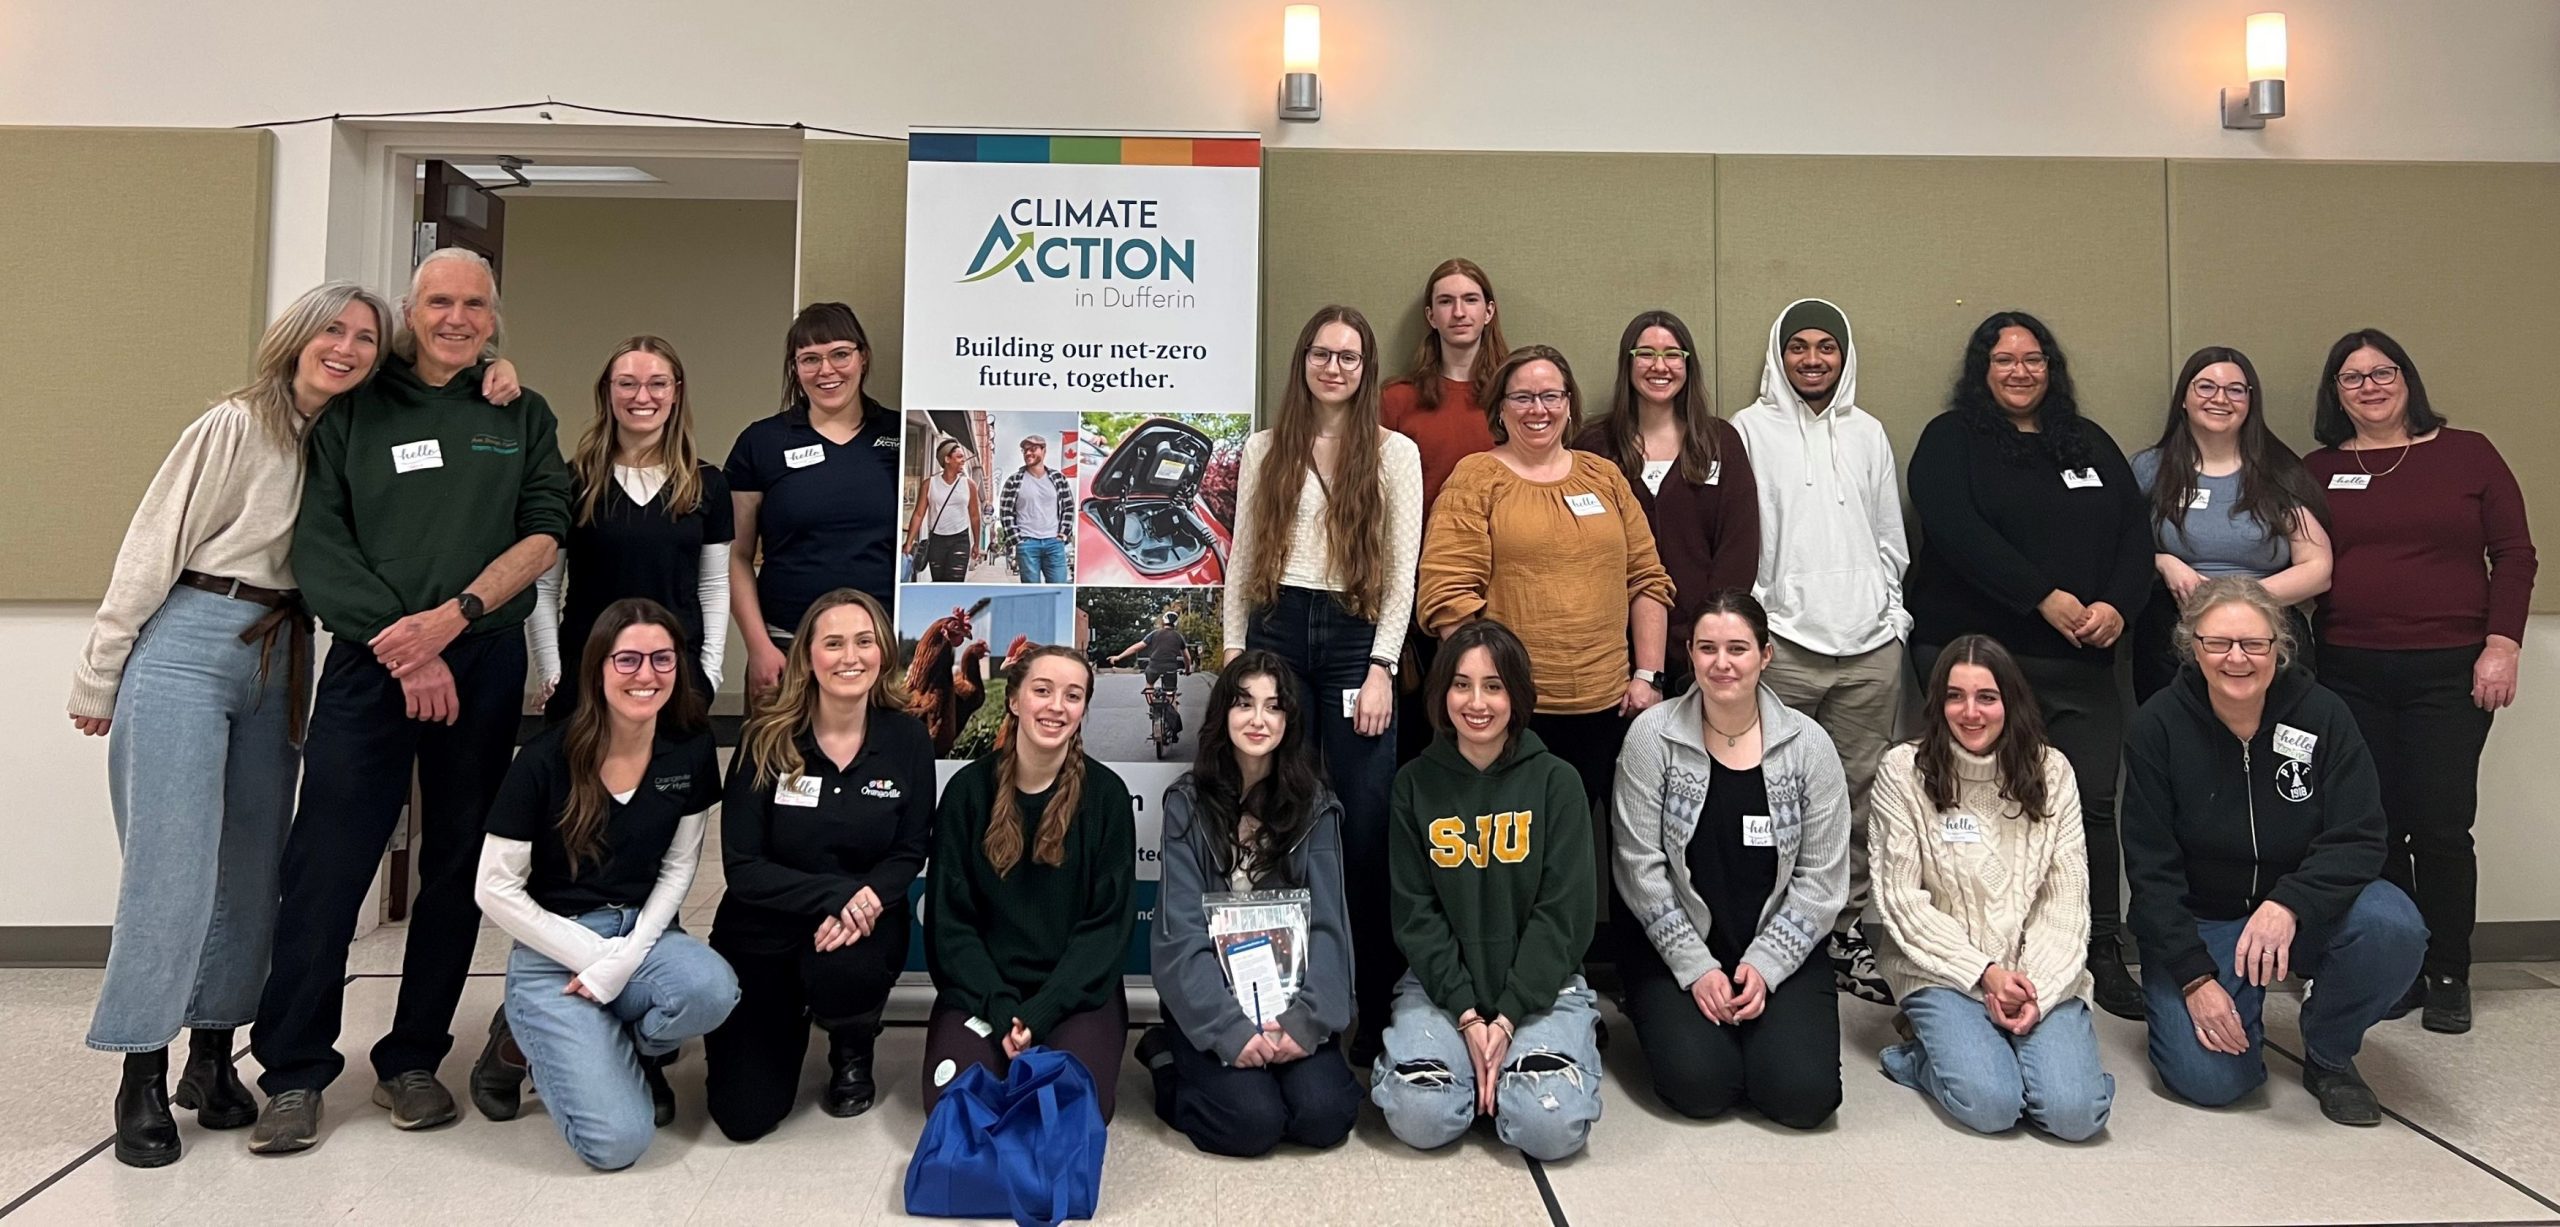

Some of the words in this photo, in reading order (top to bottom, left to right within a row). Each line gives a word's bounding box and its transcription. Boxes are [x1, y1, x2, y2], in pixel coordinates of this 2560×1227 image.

[1010, 199, 1158, 228] CLIMATE
[965, 213, 1195, 284] ACTION
[1075, 289, 1094, 308] in
[1104, 286, 1195, 309] Dufferin
[956, 337, 1054, 362] Building
[1062, 342, 1103, 359] our
[1110, 342, 1207, 360] net-zero
[979, 366, 1058, 390] future,
[1067, 369, 1175, 392] together.
[401, 444, 437, 460] hello
[791, 448, 820, 461] hello
[2280, 729, 2313, 751] hello
[1945, 817, 1975, 831] hello
[1429, 810, 1532, 868] SJU
